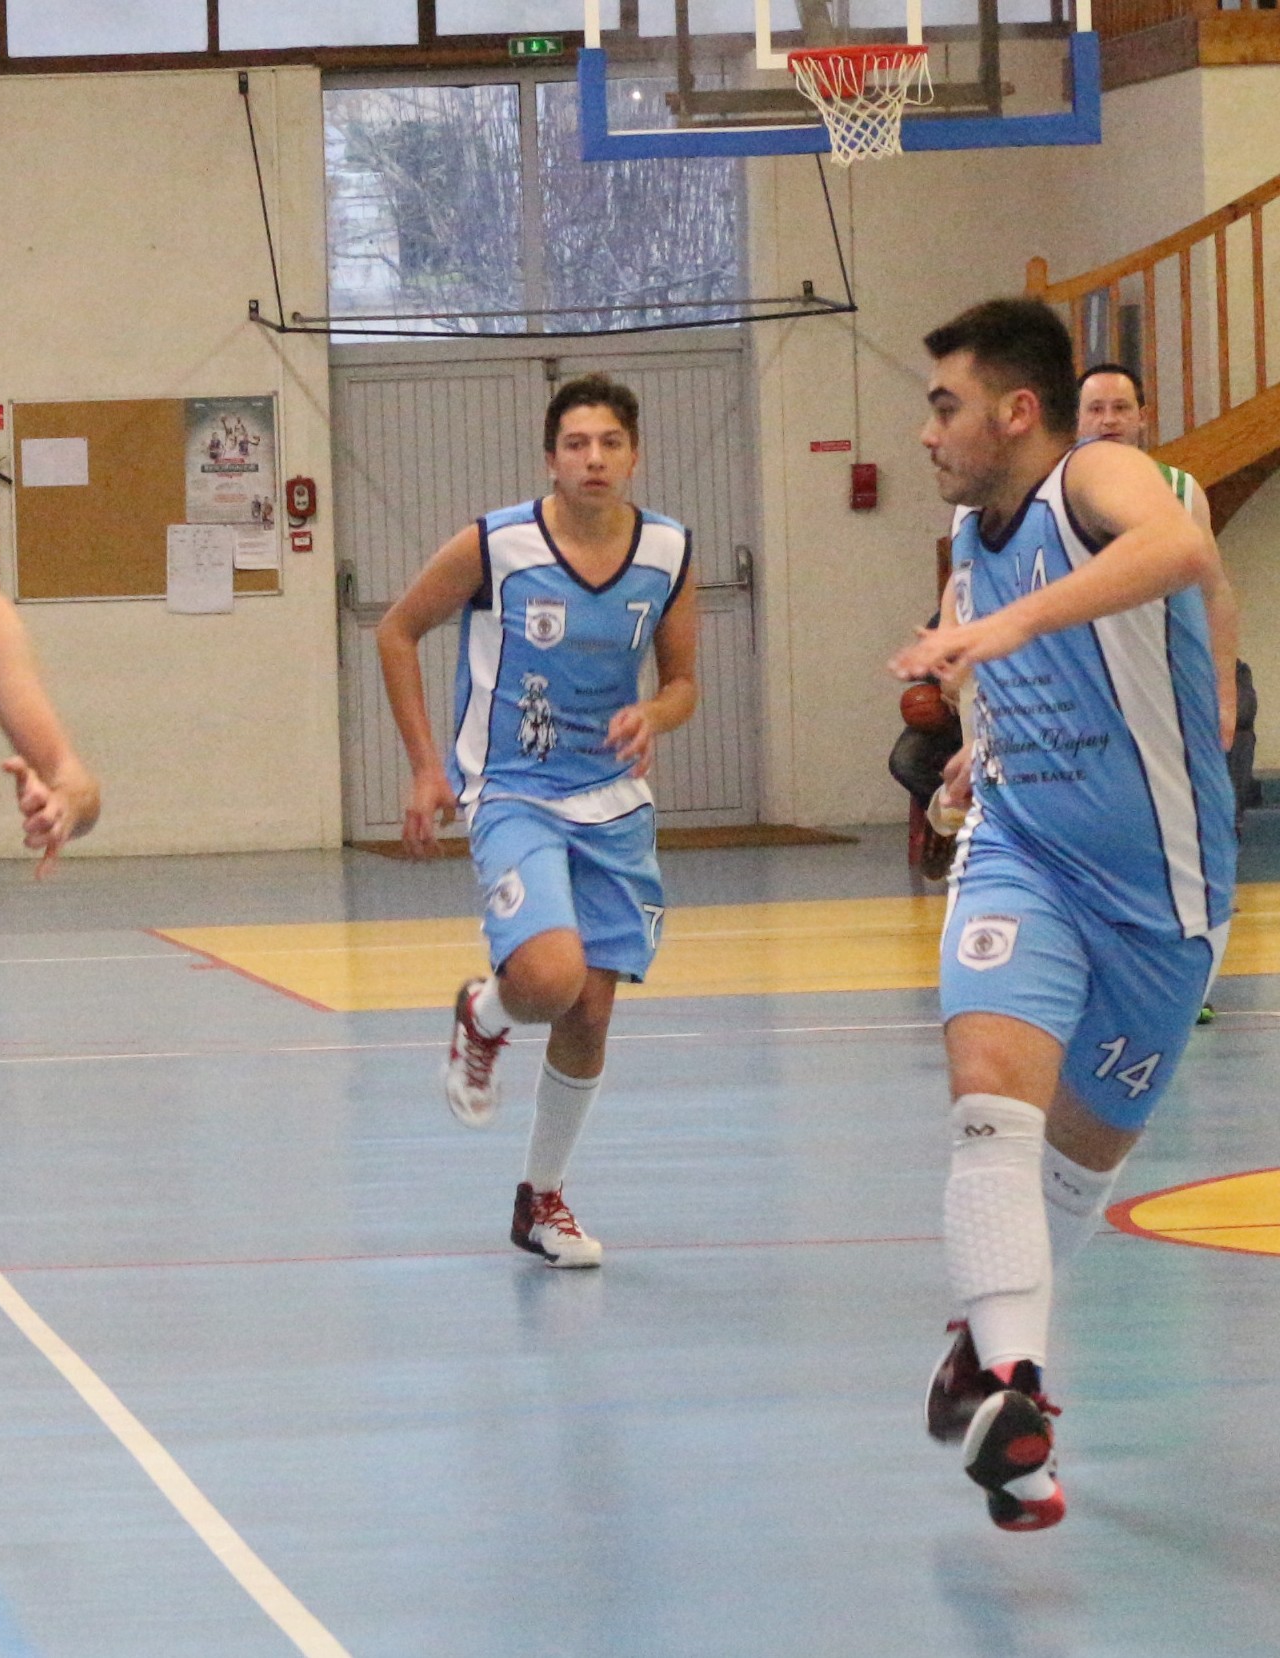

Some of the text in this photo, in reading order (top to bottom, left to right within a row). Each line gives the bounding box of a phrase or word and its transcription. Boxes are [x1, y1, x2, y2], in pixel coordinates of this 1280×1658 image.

[627, 602, 652, 650] 7
[643, 904, 664, 950] 7
[1093, 1035, 1163, 1099] 14
